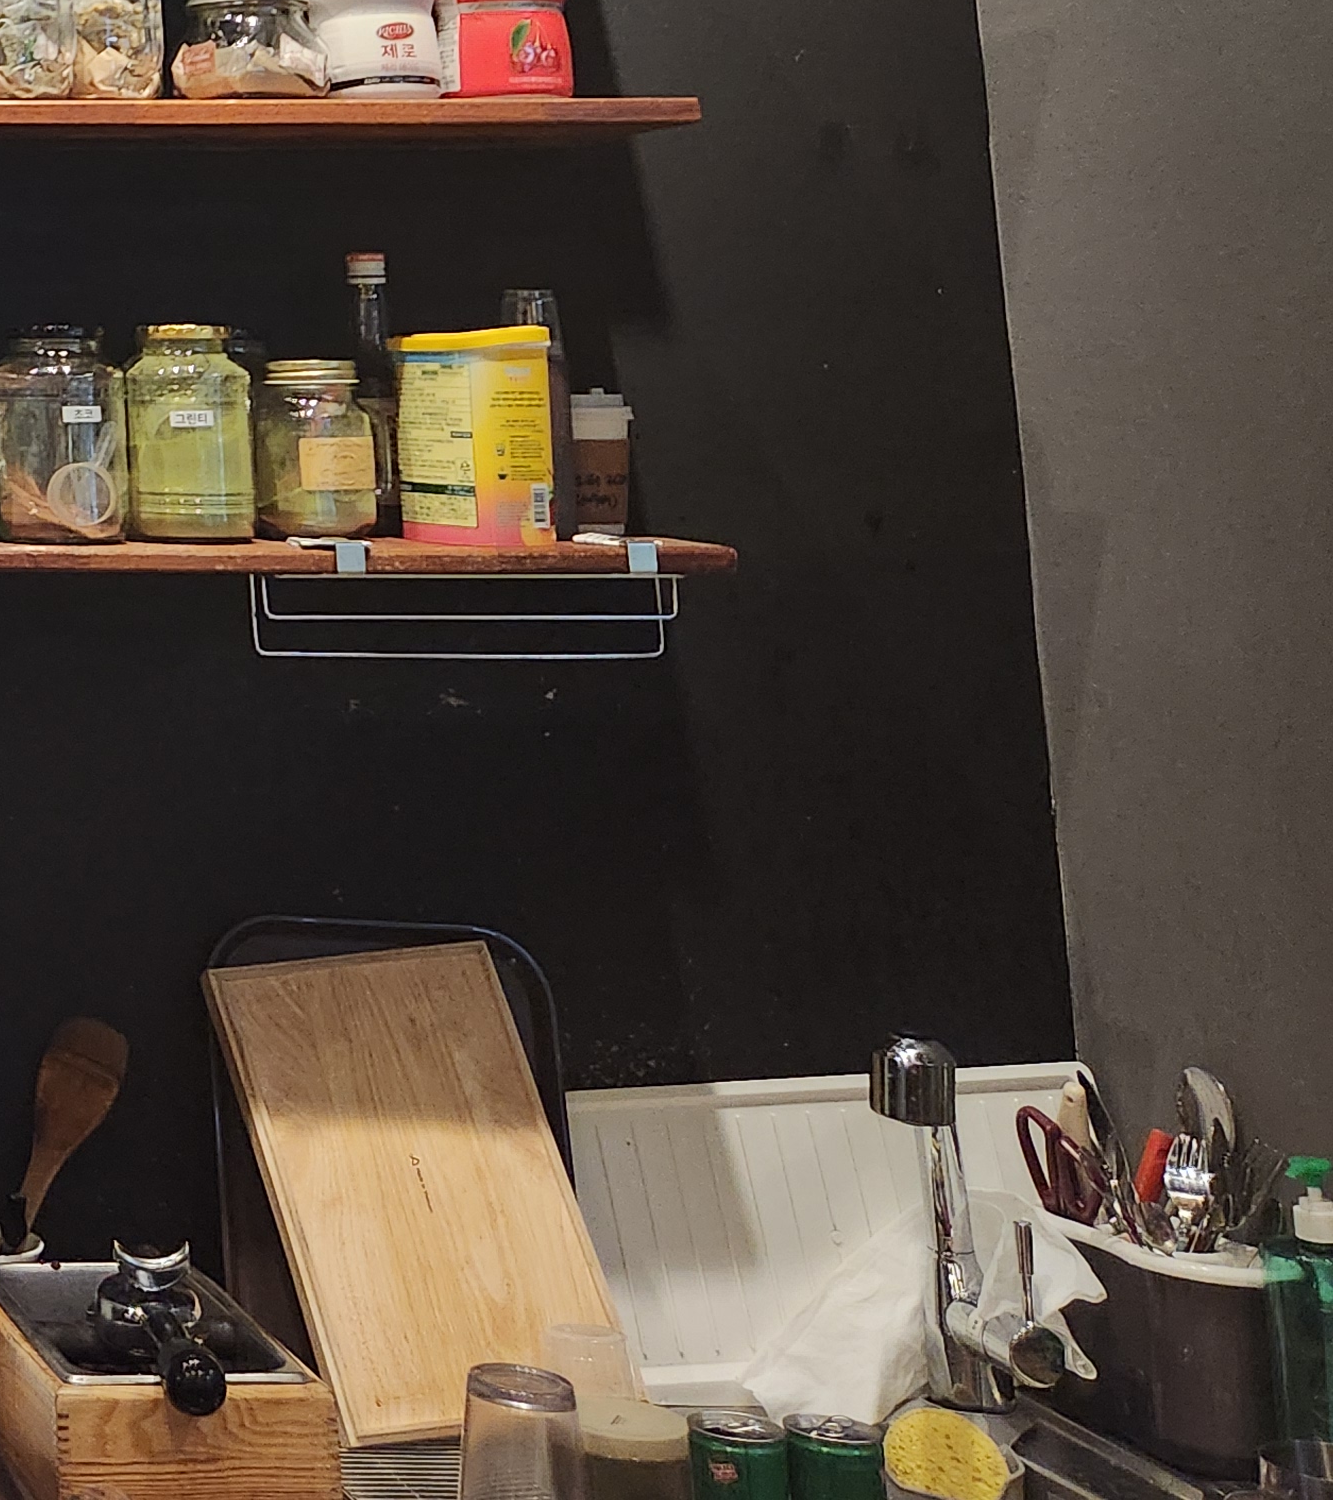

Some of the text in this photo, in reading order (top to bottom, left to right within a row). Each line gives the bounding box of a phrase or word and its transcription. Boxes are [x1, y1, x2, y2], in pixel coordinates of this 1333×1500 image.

[381, 43, 417, 59] 제로
[74, 408, 94, 421] 초코
[174, 411, 210, 428] 그린티
